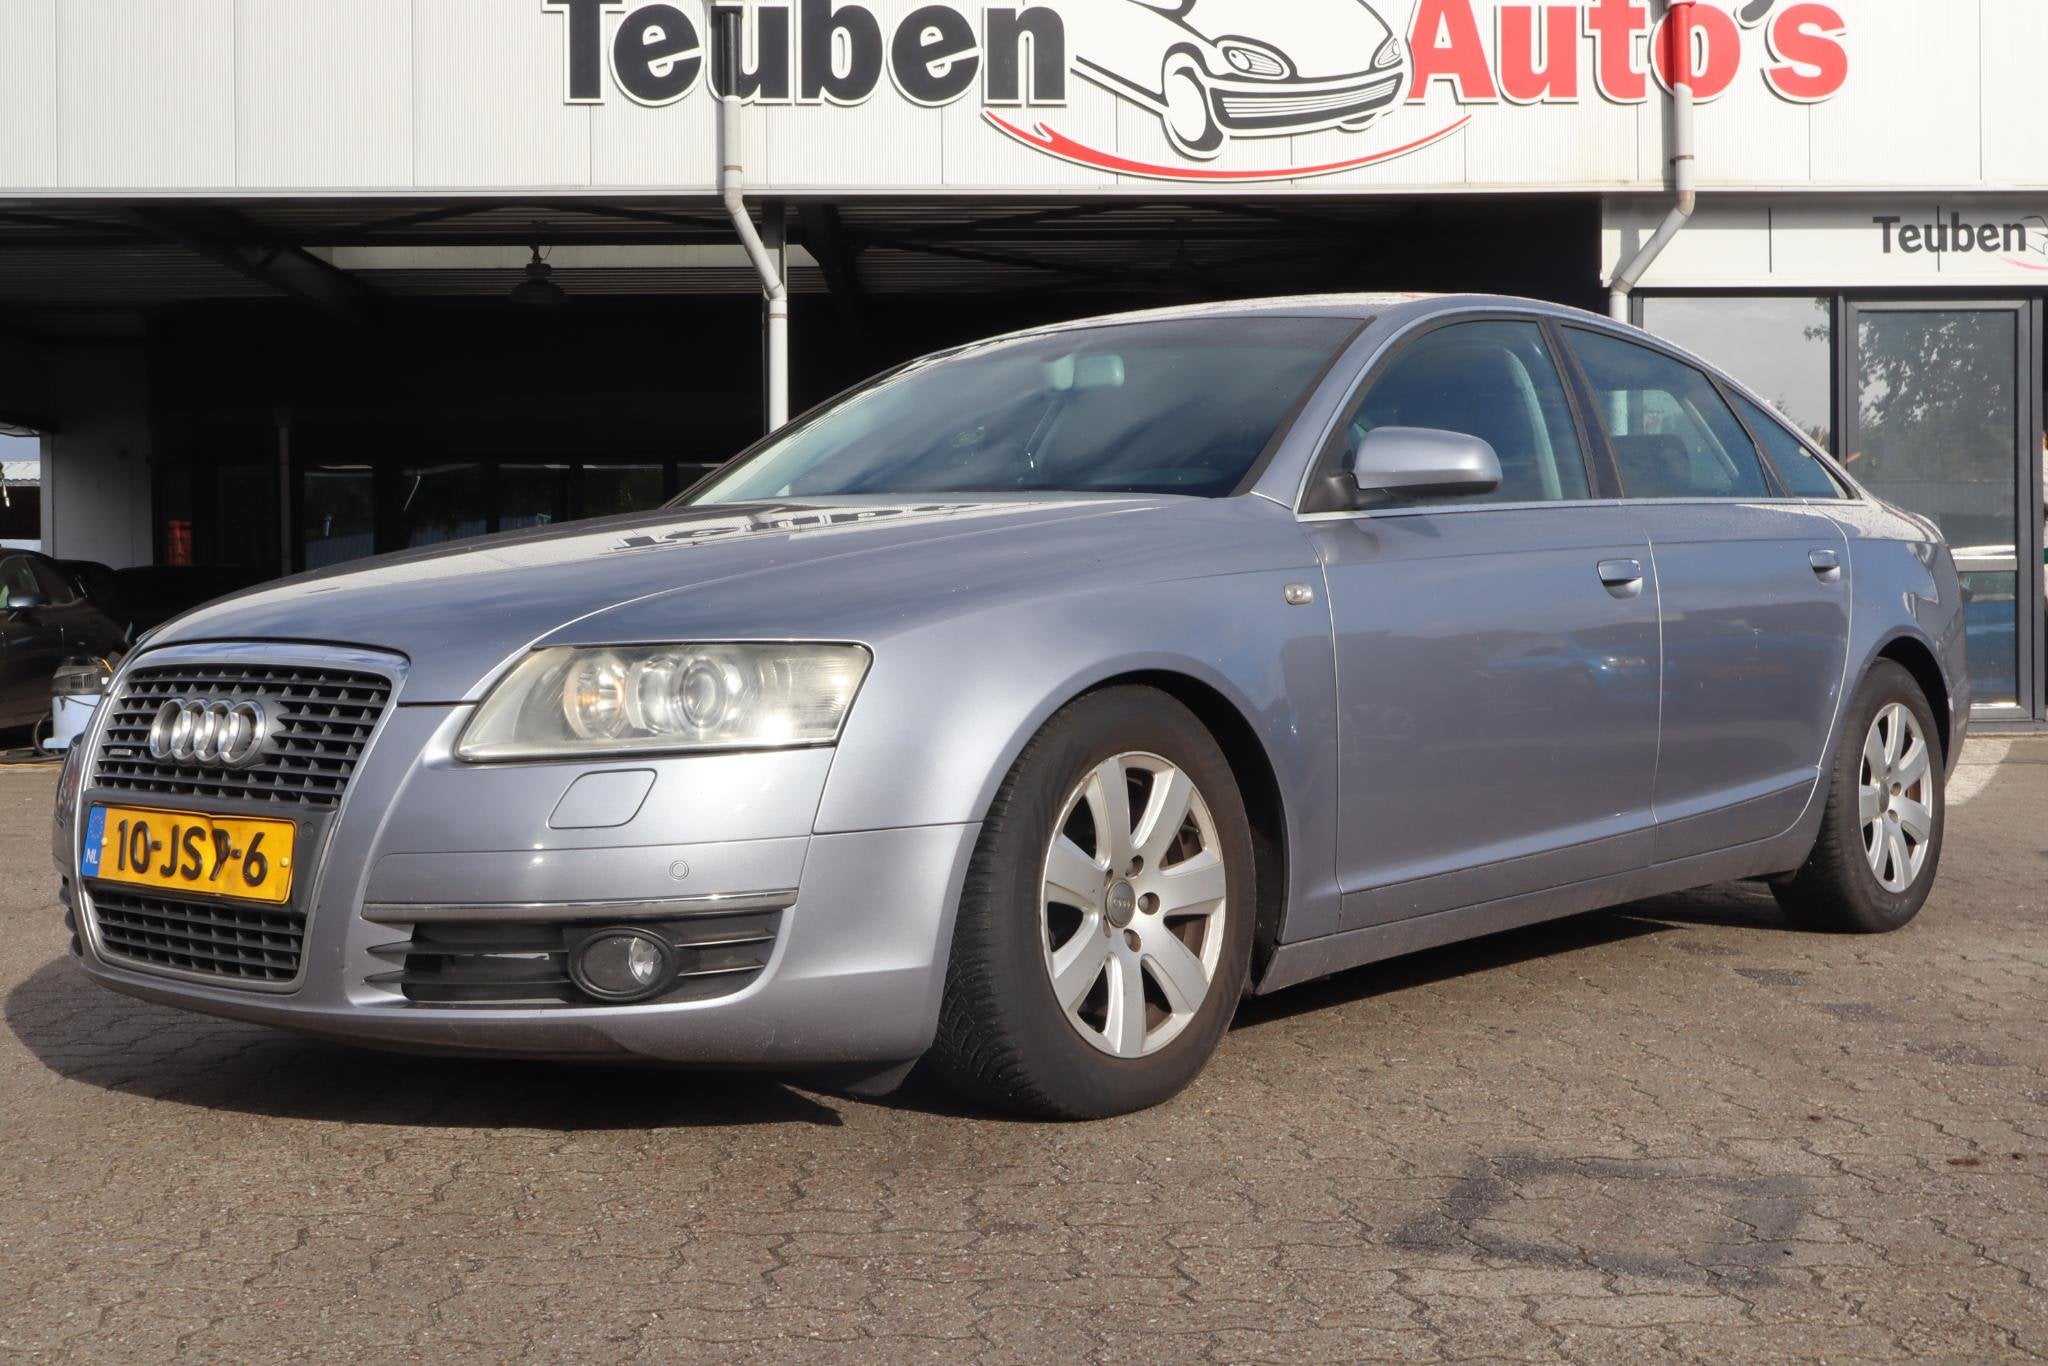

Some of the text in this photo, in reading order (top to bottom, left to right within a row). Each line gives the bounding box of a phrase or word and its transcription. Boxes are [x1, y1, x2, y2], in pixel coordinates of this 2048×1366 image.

[545, 0, 1848, 105] Teuben Auto's
[1872, 211, 2027, 254] Teuben
[85, 847, 99, 865] NL
[118, 818, 269, 888] 10-JSP-6
